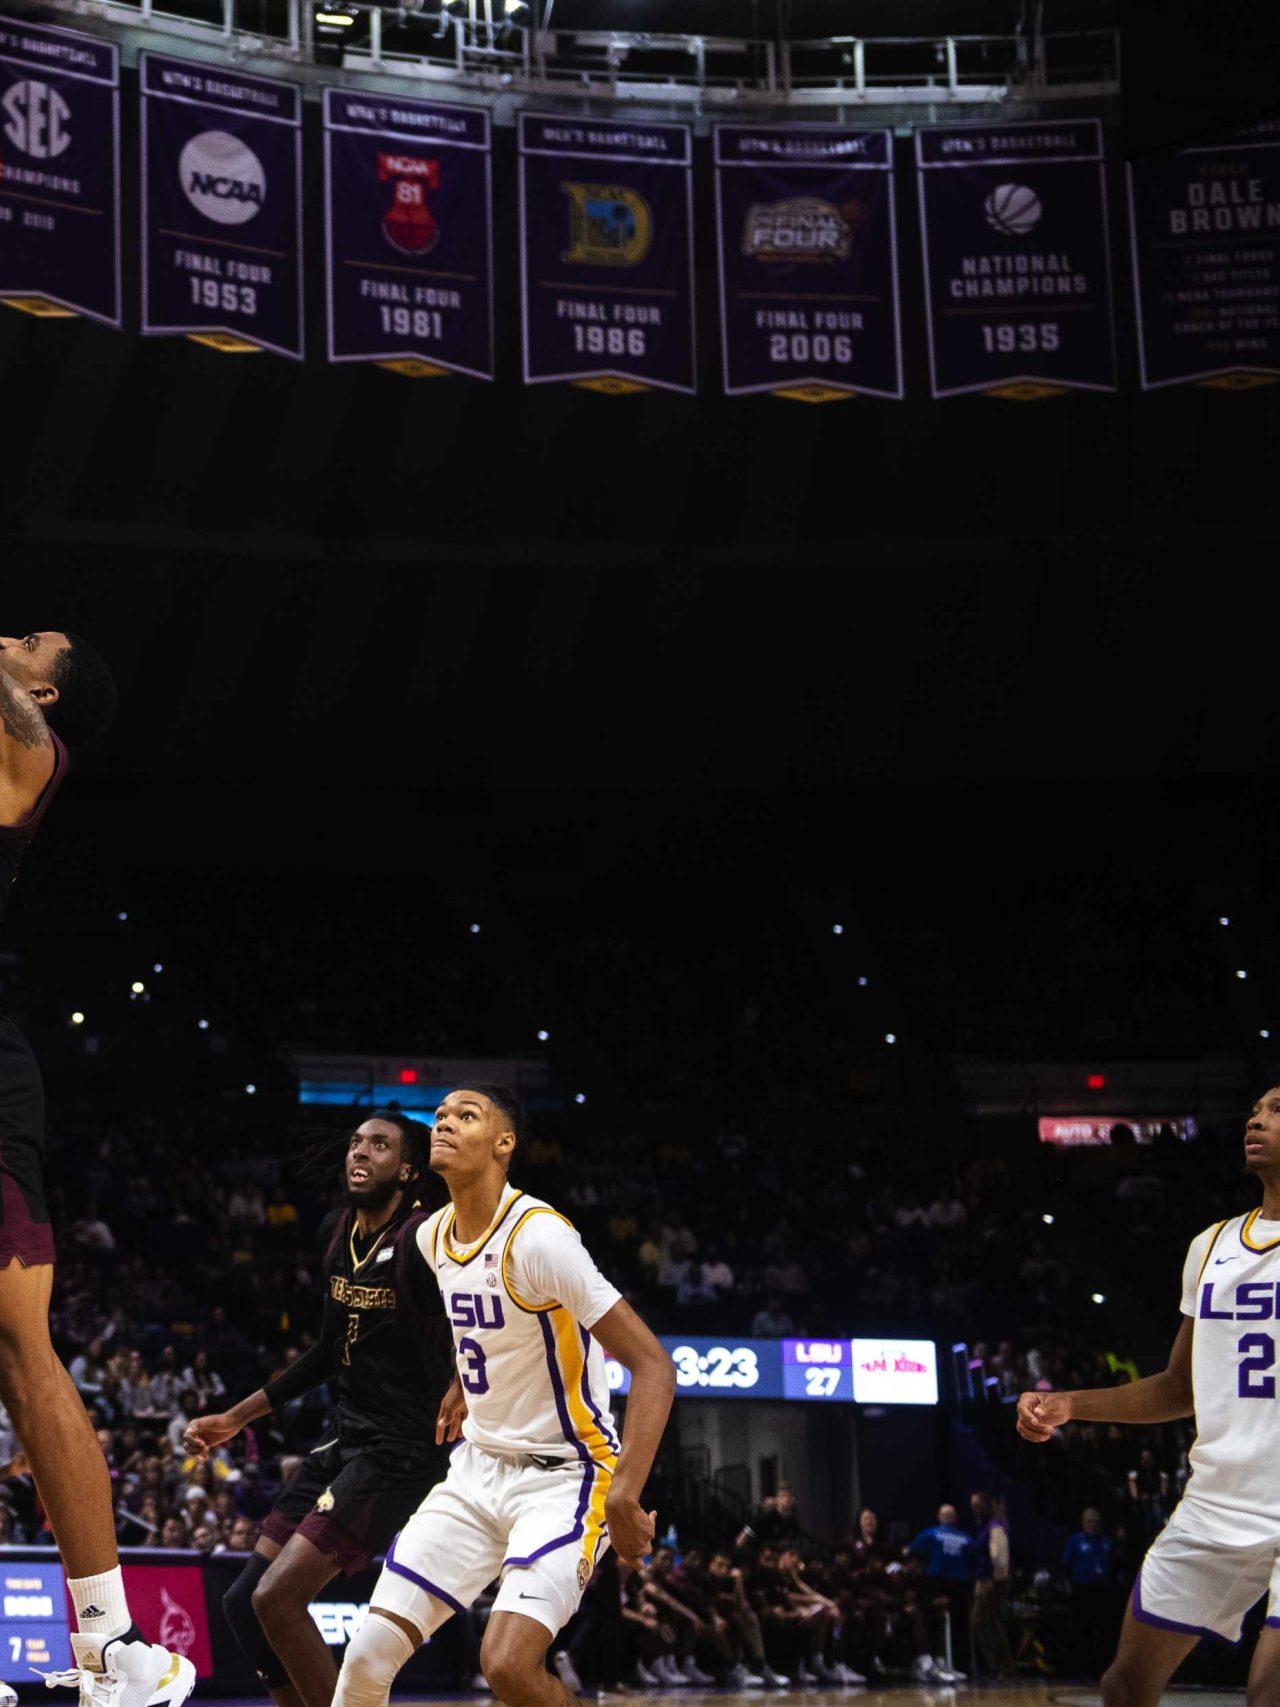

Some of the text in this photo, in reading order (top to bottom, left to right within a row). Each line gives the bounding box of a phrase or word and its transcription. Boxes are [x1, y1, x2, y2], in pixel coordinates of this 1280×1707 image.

[1, 79, 72, 159] SEC
[188, 171, 264, 206] NCAA
[1188, 179, 1265, 206] DALE
[1169, 203, 1280, 234] BROWN
[175, 250, 272, 285] FINAL FOUR
[962, 254, 1072, 277] NATIONAL
[189, 276, 258, 317] 1953
[360, 279, 461, 309] FINAL FOUR
[950, 274, 1087, 299] CHAMPIONS
[380, 306, 443, 340] 1981
[556, 300, 662, 327] FINAL FOUR
[756, 310, 863, 331] FINAL FOUR
[574, 325, 647, 357] 1986
[770, 335, 853, 364] 2006
[982, 324, 1060, 353] 1935
[447, 1292, 506, 1329] SU
[459, 1337, 490, 1395] 3
[671, 1345, 759, 1388] 3:23
[795, 1343, 842, 1365] LSU
[1238, 1333, 1276, 1399] 2
[805, 1367, 841, 1397] 27
